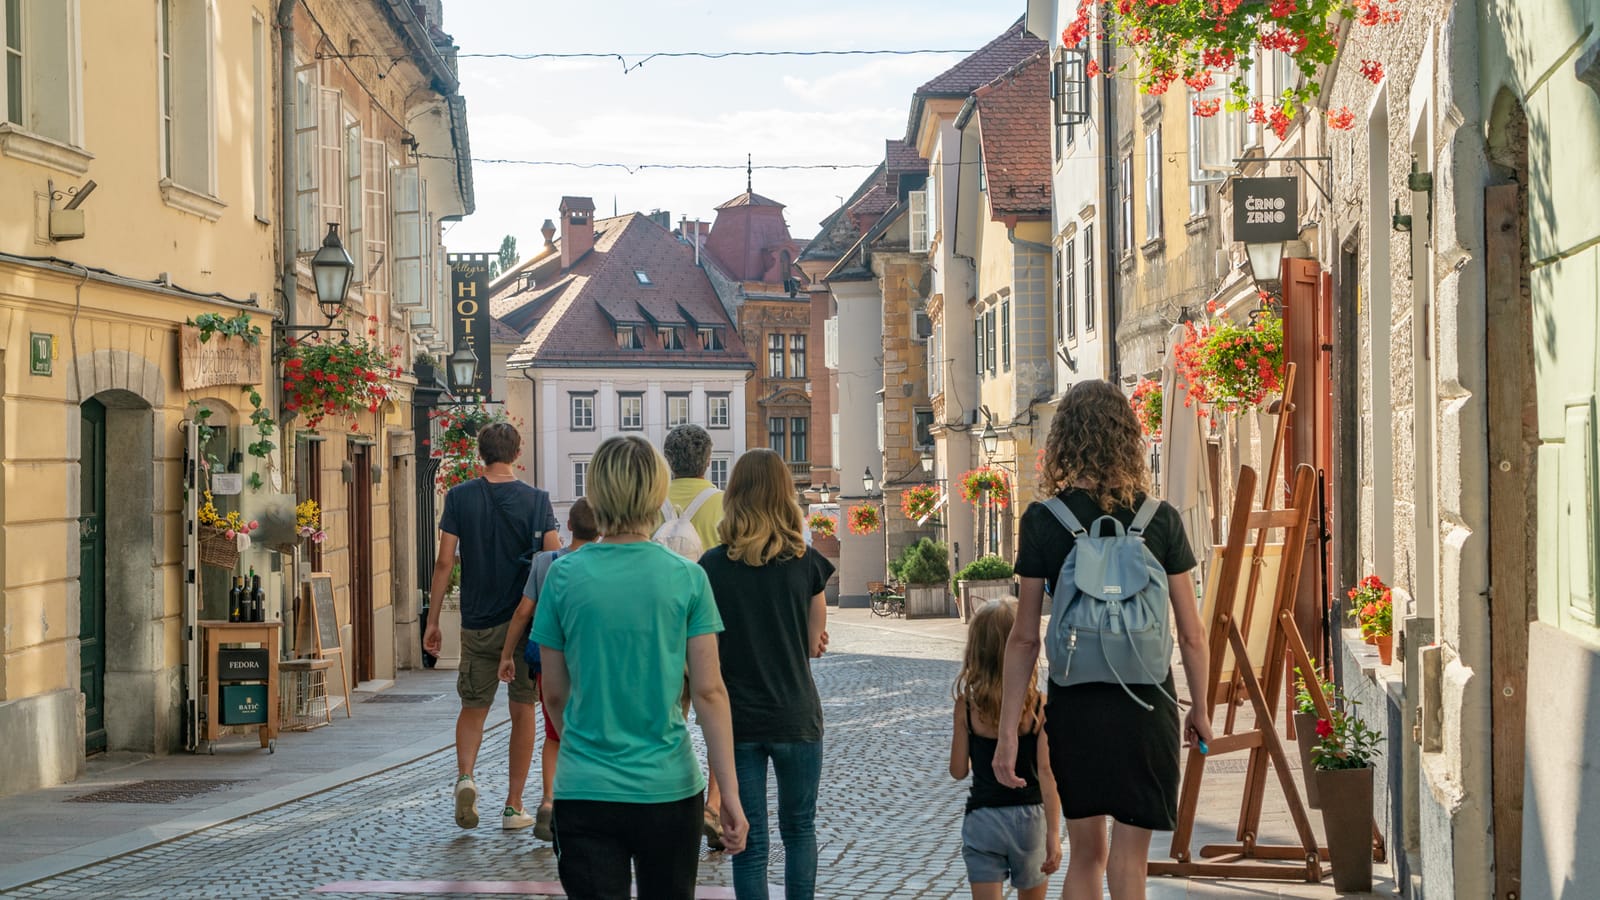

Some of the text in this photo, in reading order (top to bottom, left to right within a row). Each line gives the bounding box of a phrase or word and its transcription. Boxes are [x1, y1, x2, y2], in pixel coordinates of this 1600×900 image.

[1245, 195, 1285, 210] ČRNO
[1246, 211, 1285, 223] ZRNO
[457, 281, 479, 353] HOTE
[38, 339, 47, 360] 10
[229, 661, 259, 669] FEDORA
